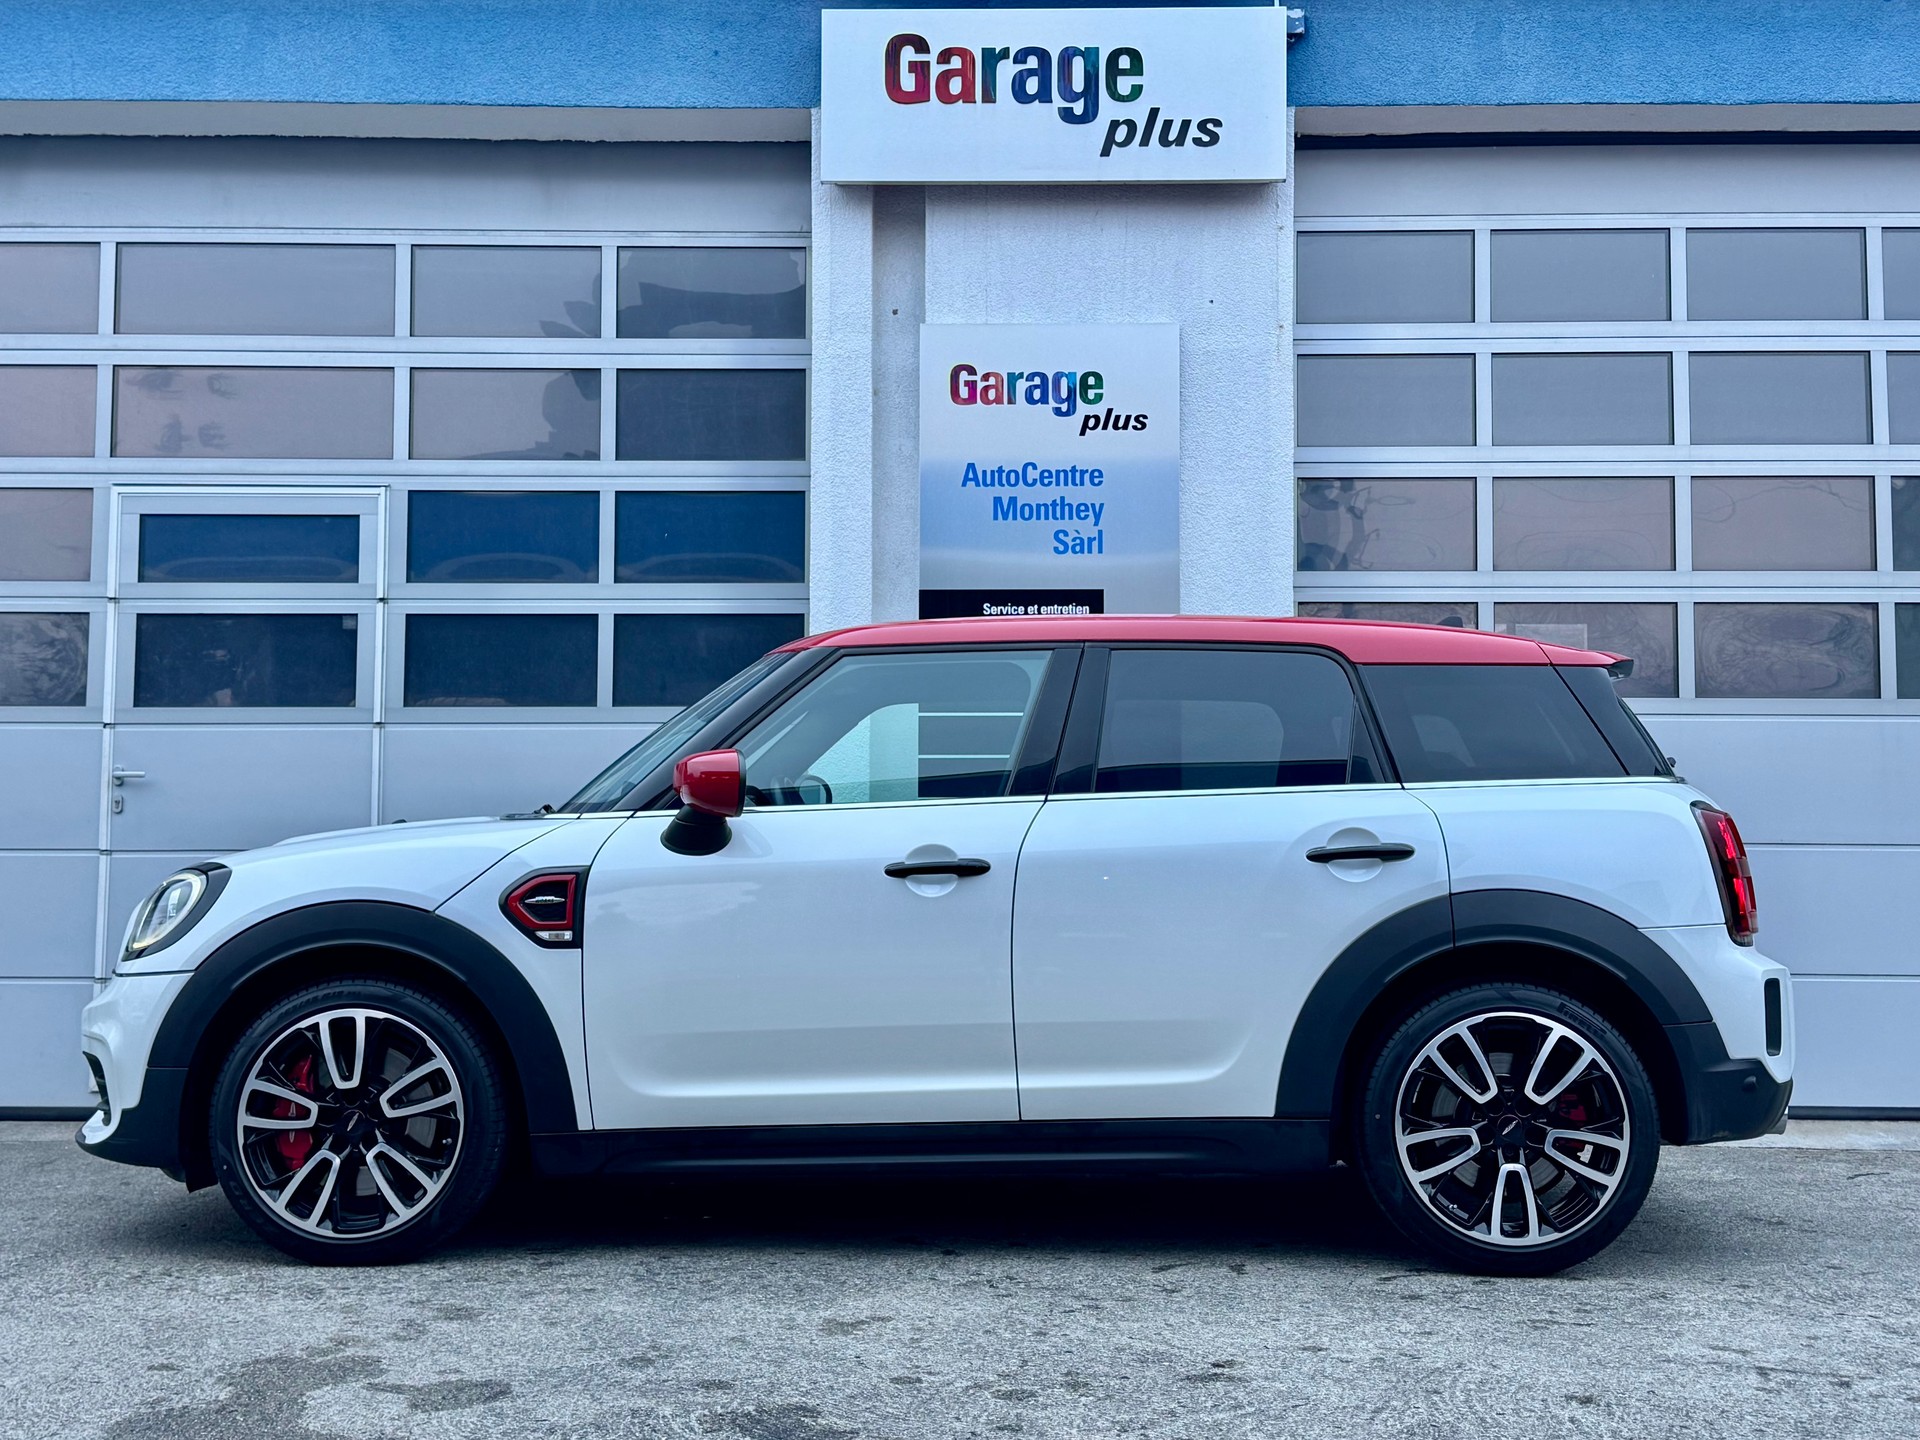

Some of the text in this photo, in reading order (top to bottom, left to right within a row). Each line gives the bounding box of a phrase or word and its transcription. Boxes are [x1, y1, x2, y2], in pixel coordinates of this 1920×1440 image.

[885, 33, 1144, 124] Garage
[1099, 107, 1224, 157] plus
[950, 364, 1104, 417] Garage
[1079, 408, 1149, 436] plus
[961, 462, 1104, 487] AutoCentre
[992, 496, 1104, 526] Monthey
[1053, 530, 1104, 554] Sàrl
[983, 603, 1090, 615] Service et entretien
